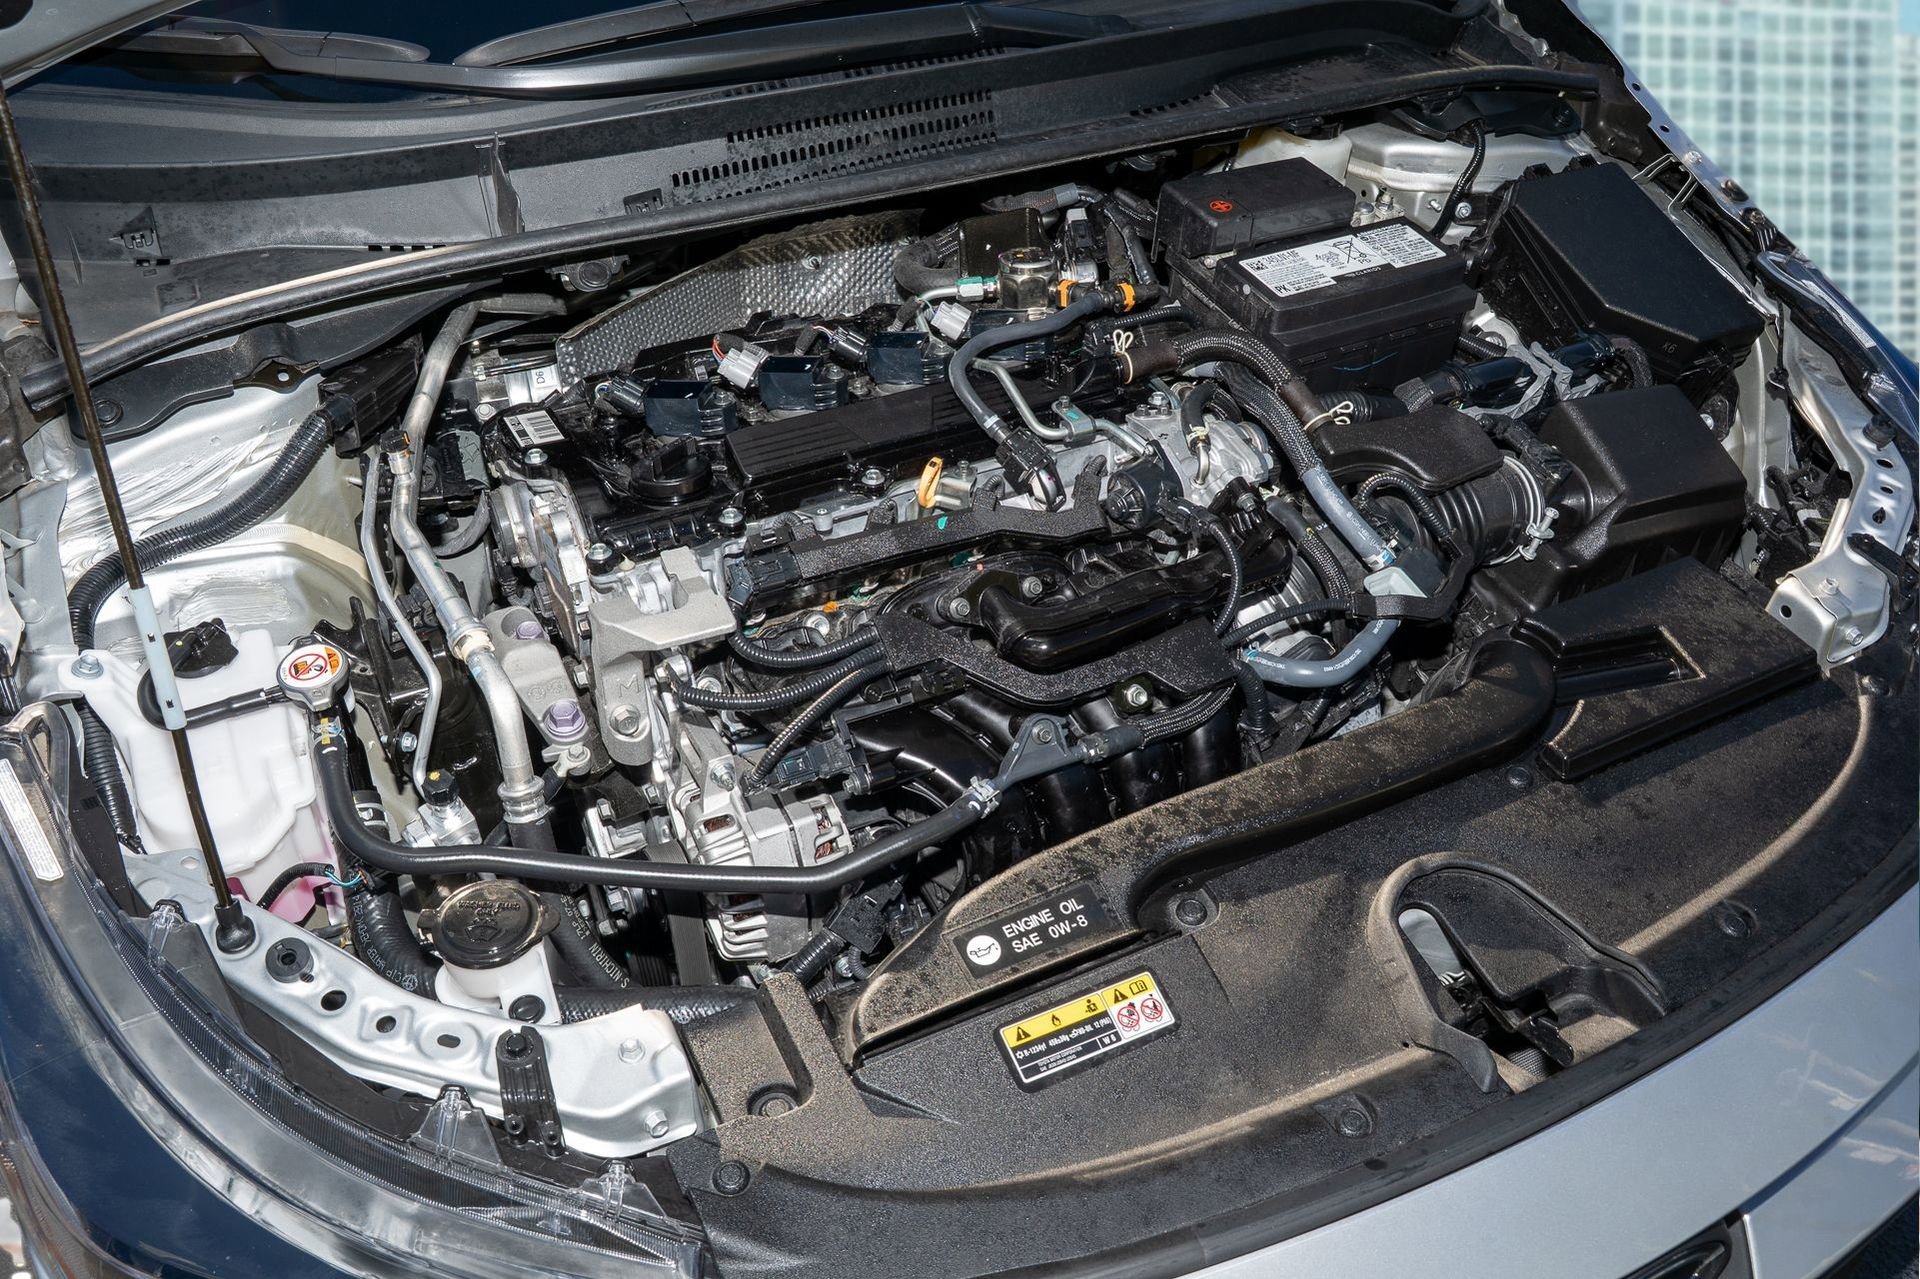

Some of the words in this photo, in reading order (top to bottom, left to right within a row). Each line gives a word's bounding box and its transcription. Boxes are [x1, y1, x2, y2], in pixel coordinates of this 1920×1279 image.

[1275, 284, 1291, 294] PK
[1001, 908, 1056, 938] ENGINE
[1059, 897, 1085, 915] OIL
[1011, 932, 1043, 953] SAE
[1048, 914, 1089, 939] 0W-8
